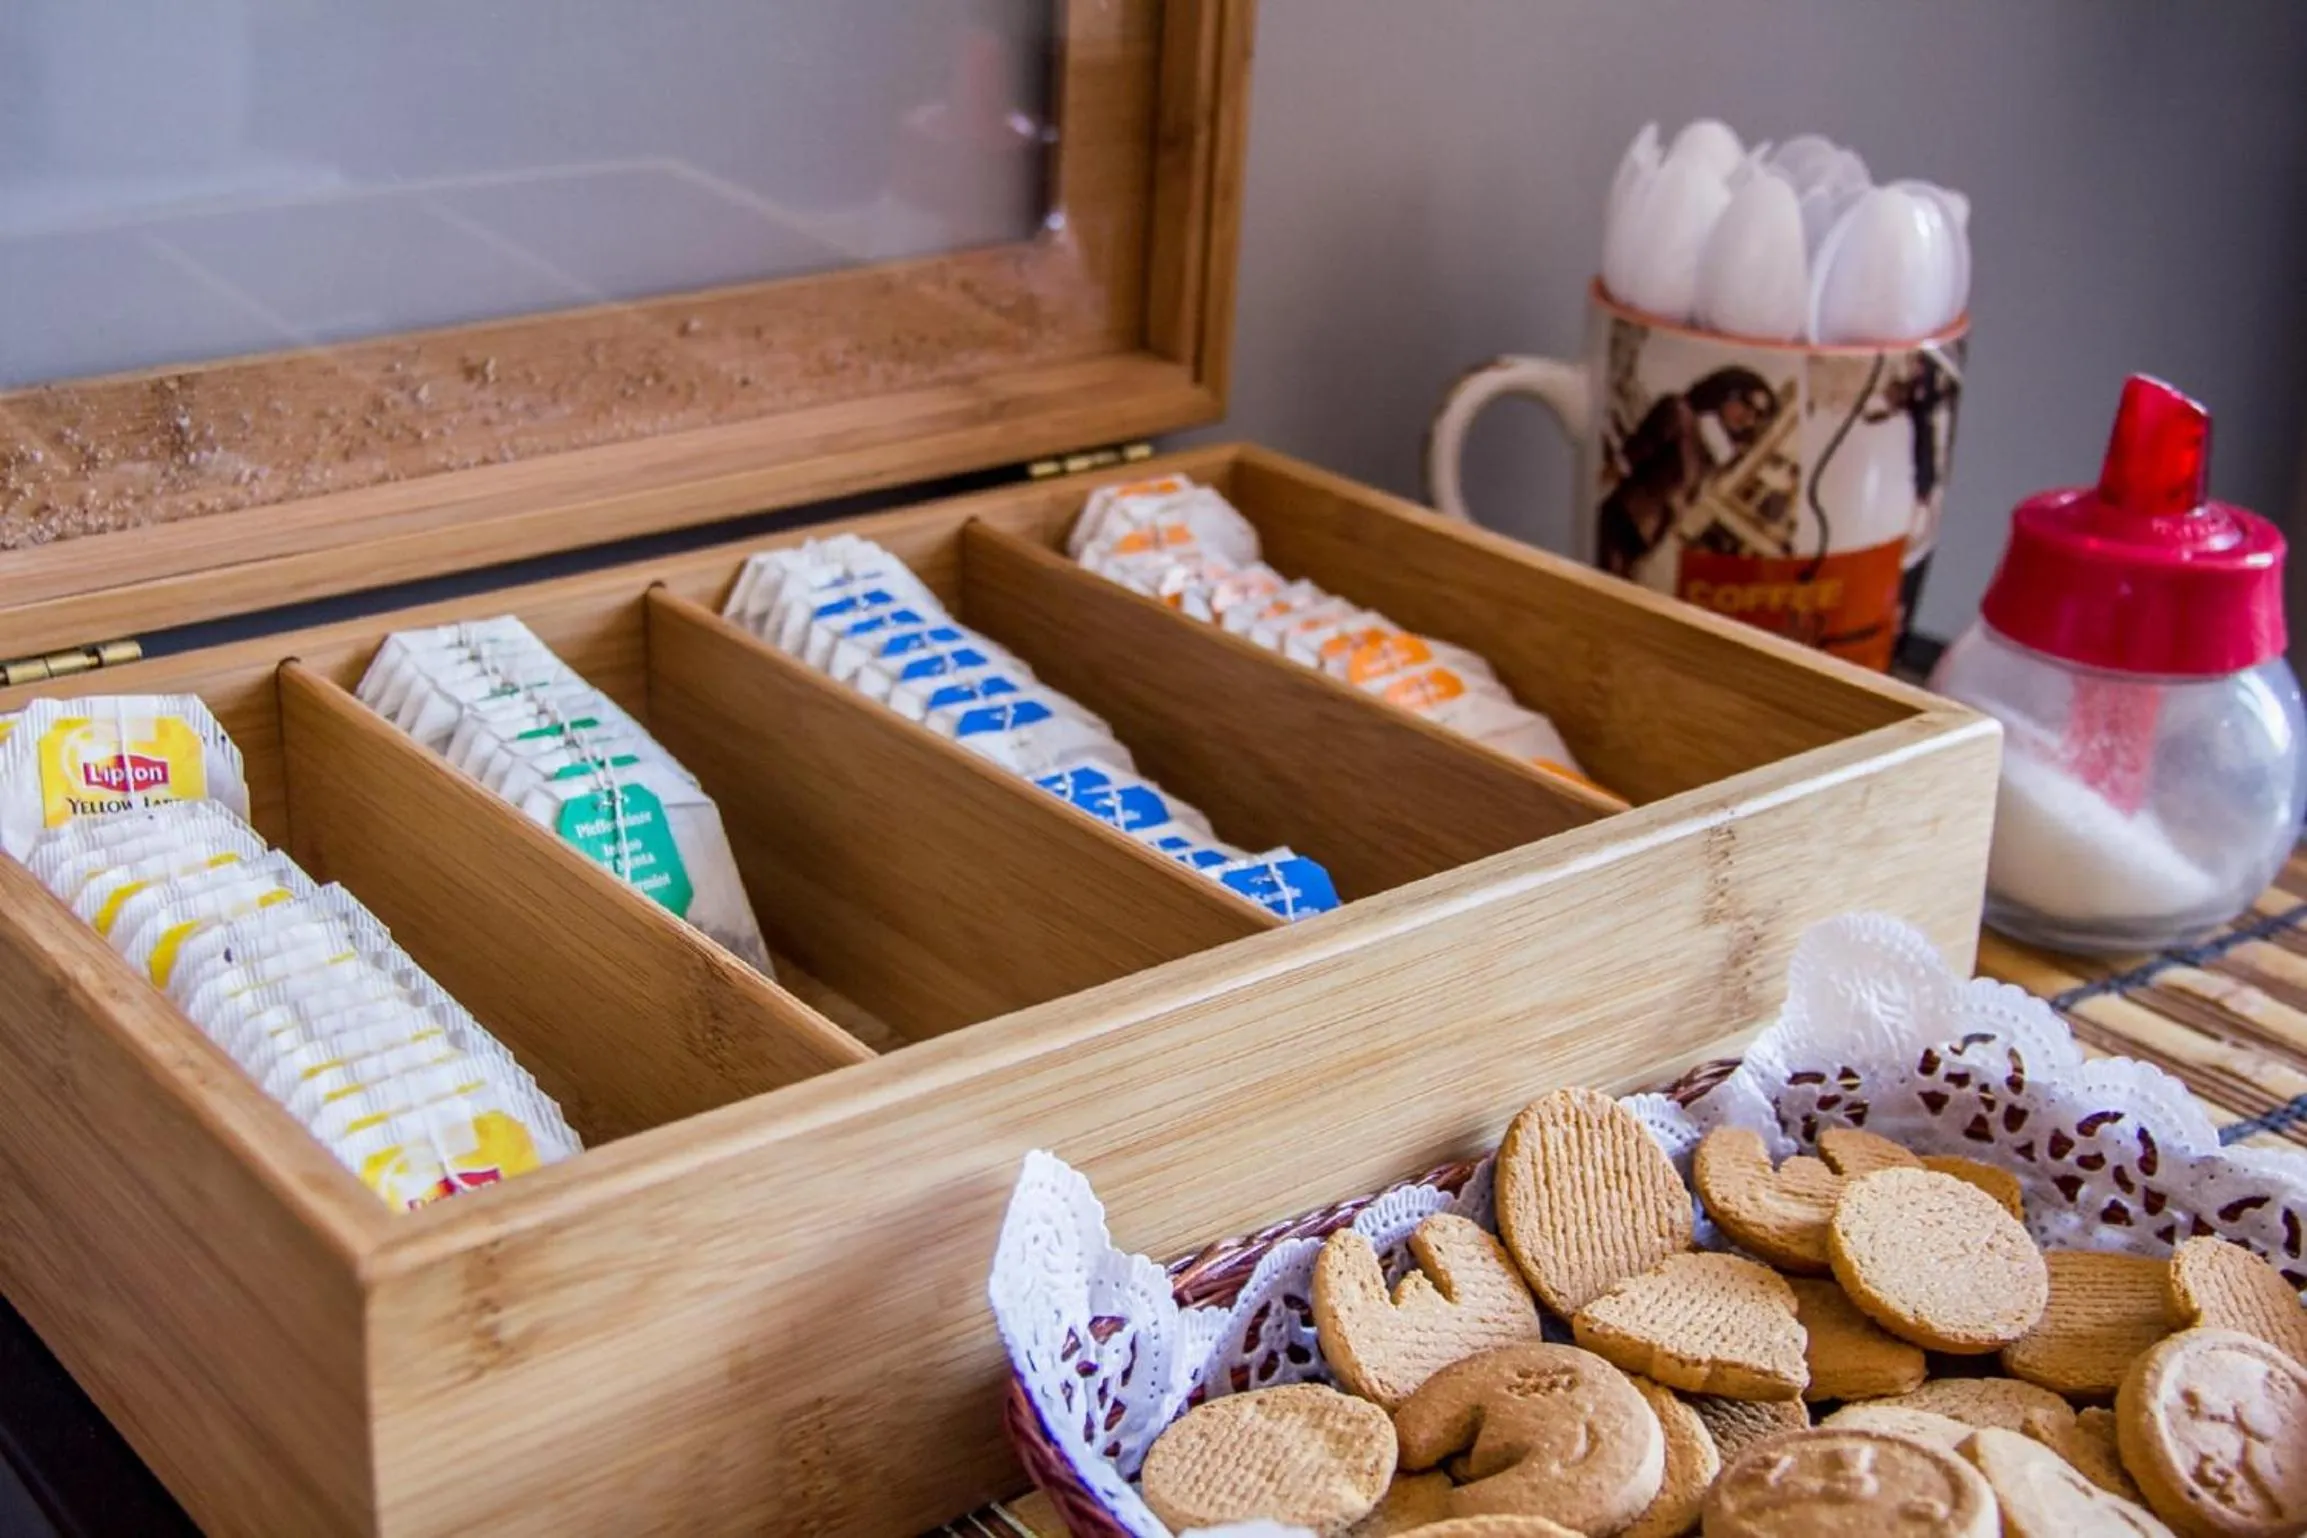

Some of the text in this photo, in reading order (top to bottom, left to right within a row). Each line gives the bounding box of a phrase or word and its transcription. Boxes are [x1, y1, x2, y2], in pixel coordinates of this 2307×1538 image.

[1687, 577, 1843, 612] COFFEE
[89, 764, 163, 786] Lipon
[66, 797, 133, 815] YELLOW
